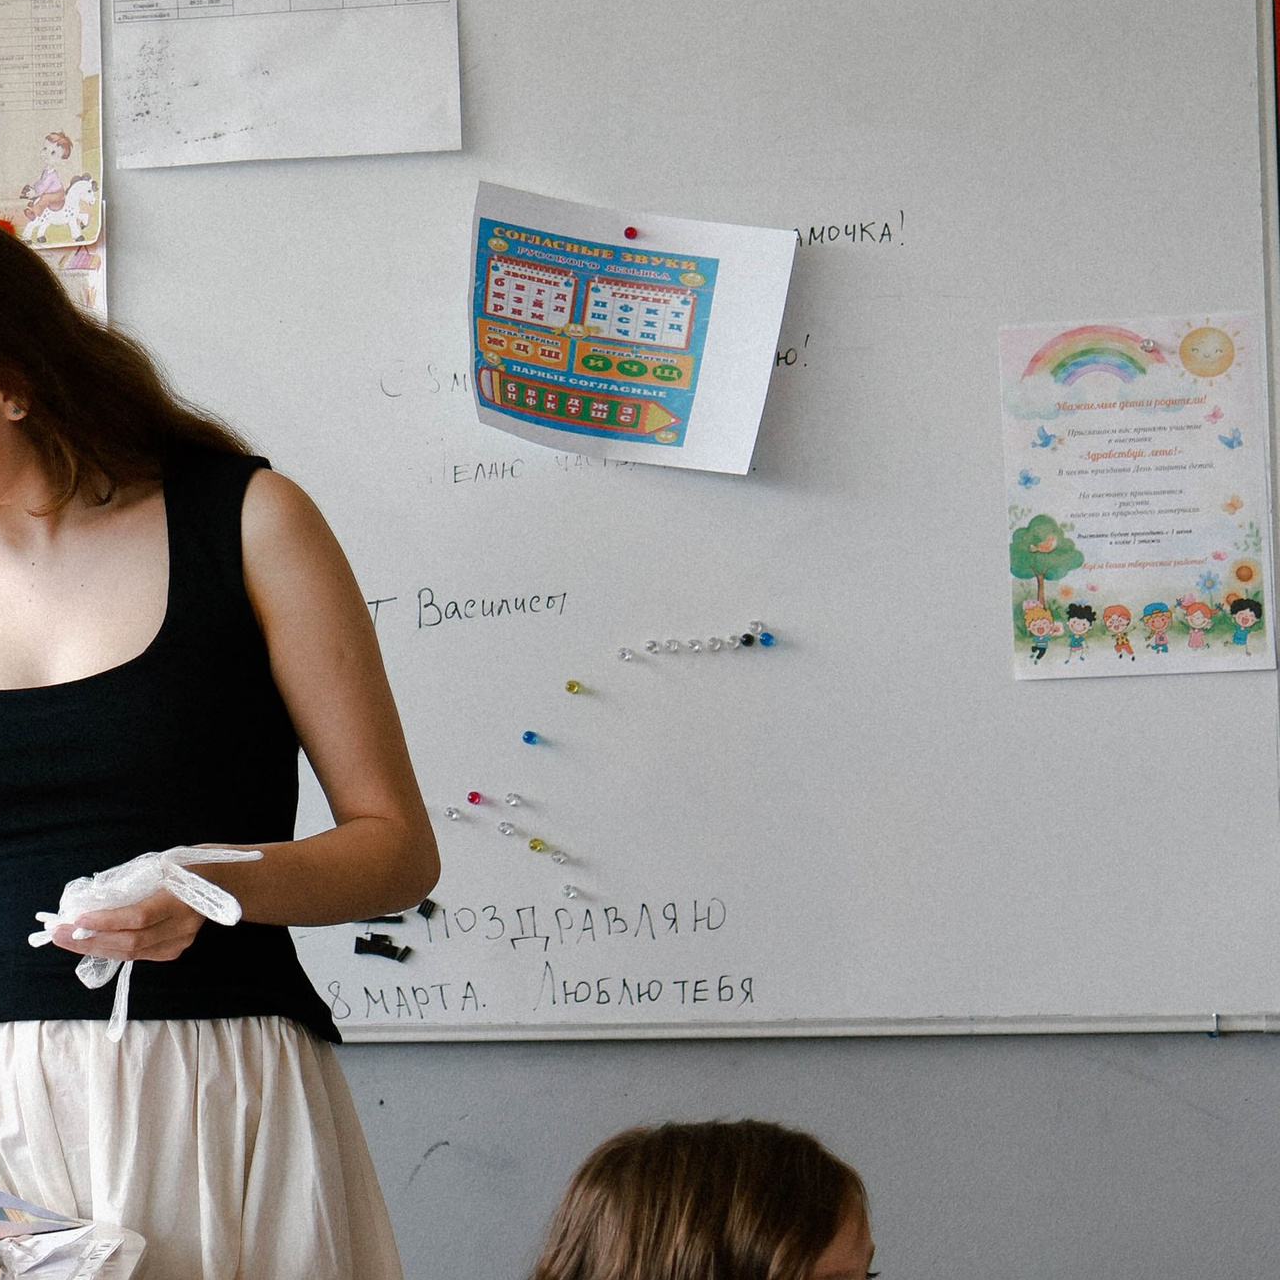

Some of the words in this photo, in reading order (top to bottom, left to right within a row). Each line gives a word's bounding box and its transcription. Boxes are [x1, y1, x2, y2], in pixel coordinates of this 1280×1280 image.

[794, 209, 904, 247] АМОЧКА!
[493, 226, 614, 259] СОГЛАСНЫЕ
[621, 252, 699, 271] ЗВУКИ
[517, 246, 600, 270] РУССКОГО
[605, 264, 671, 281] ЯЗЫКА
[504, 270, 560, 287] ЗВОНКИЕ
[611, 292, 671, 305] ГЛУХИЕ
[487, 325, 518, 337] ВСЕГДА
[591, 347, 632, 358] ВСЕГДА
[512, 364, 566, 383] ПАРНЫЕ
[569, 378, 667, 398] СОГЛАСНЫЕ
[1055, 401, 1117, 410] Уважаемые
[1153, 394, 1208, 409] родители!
[453, 459, 524, 484] ЕЛАЮ
[426, 897, 728, 952] ПОЗДРАВЛЯЮ
[328, 980, 351, 1020] 8
